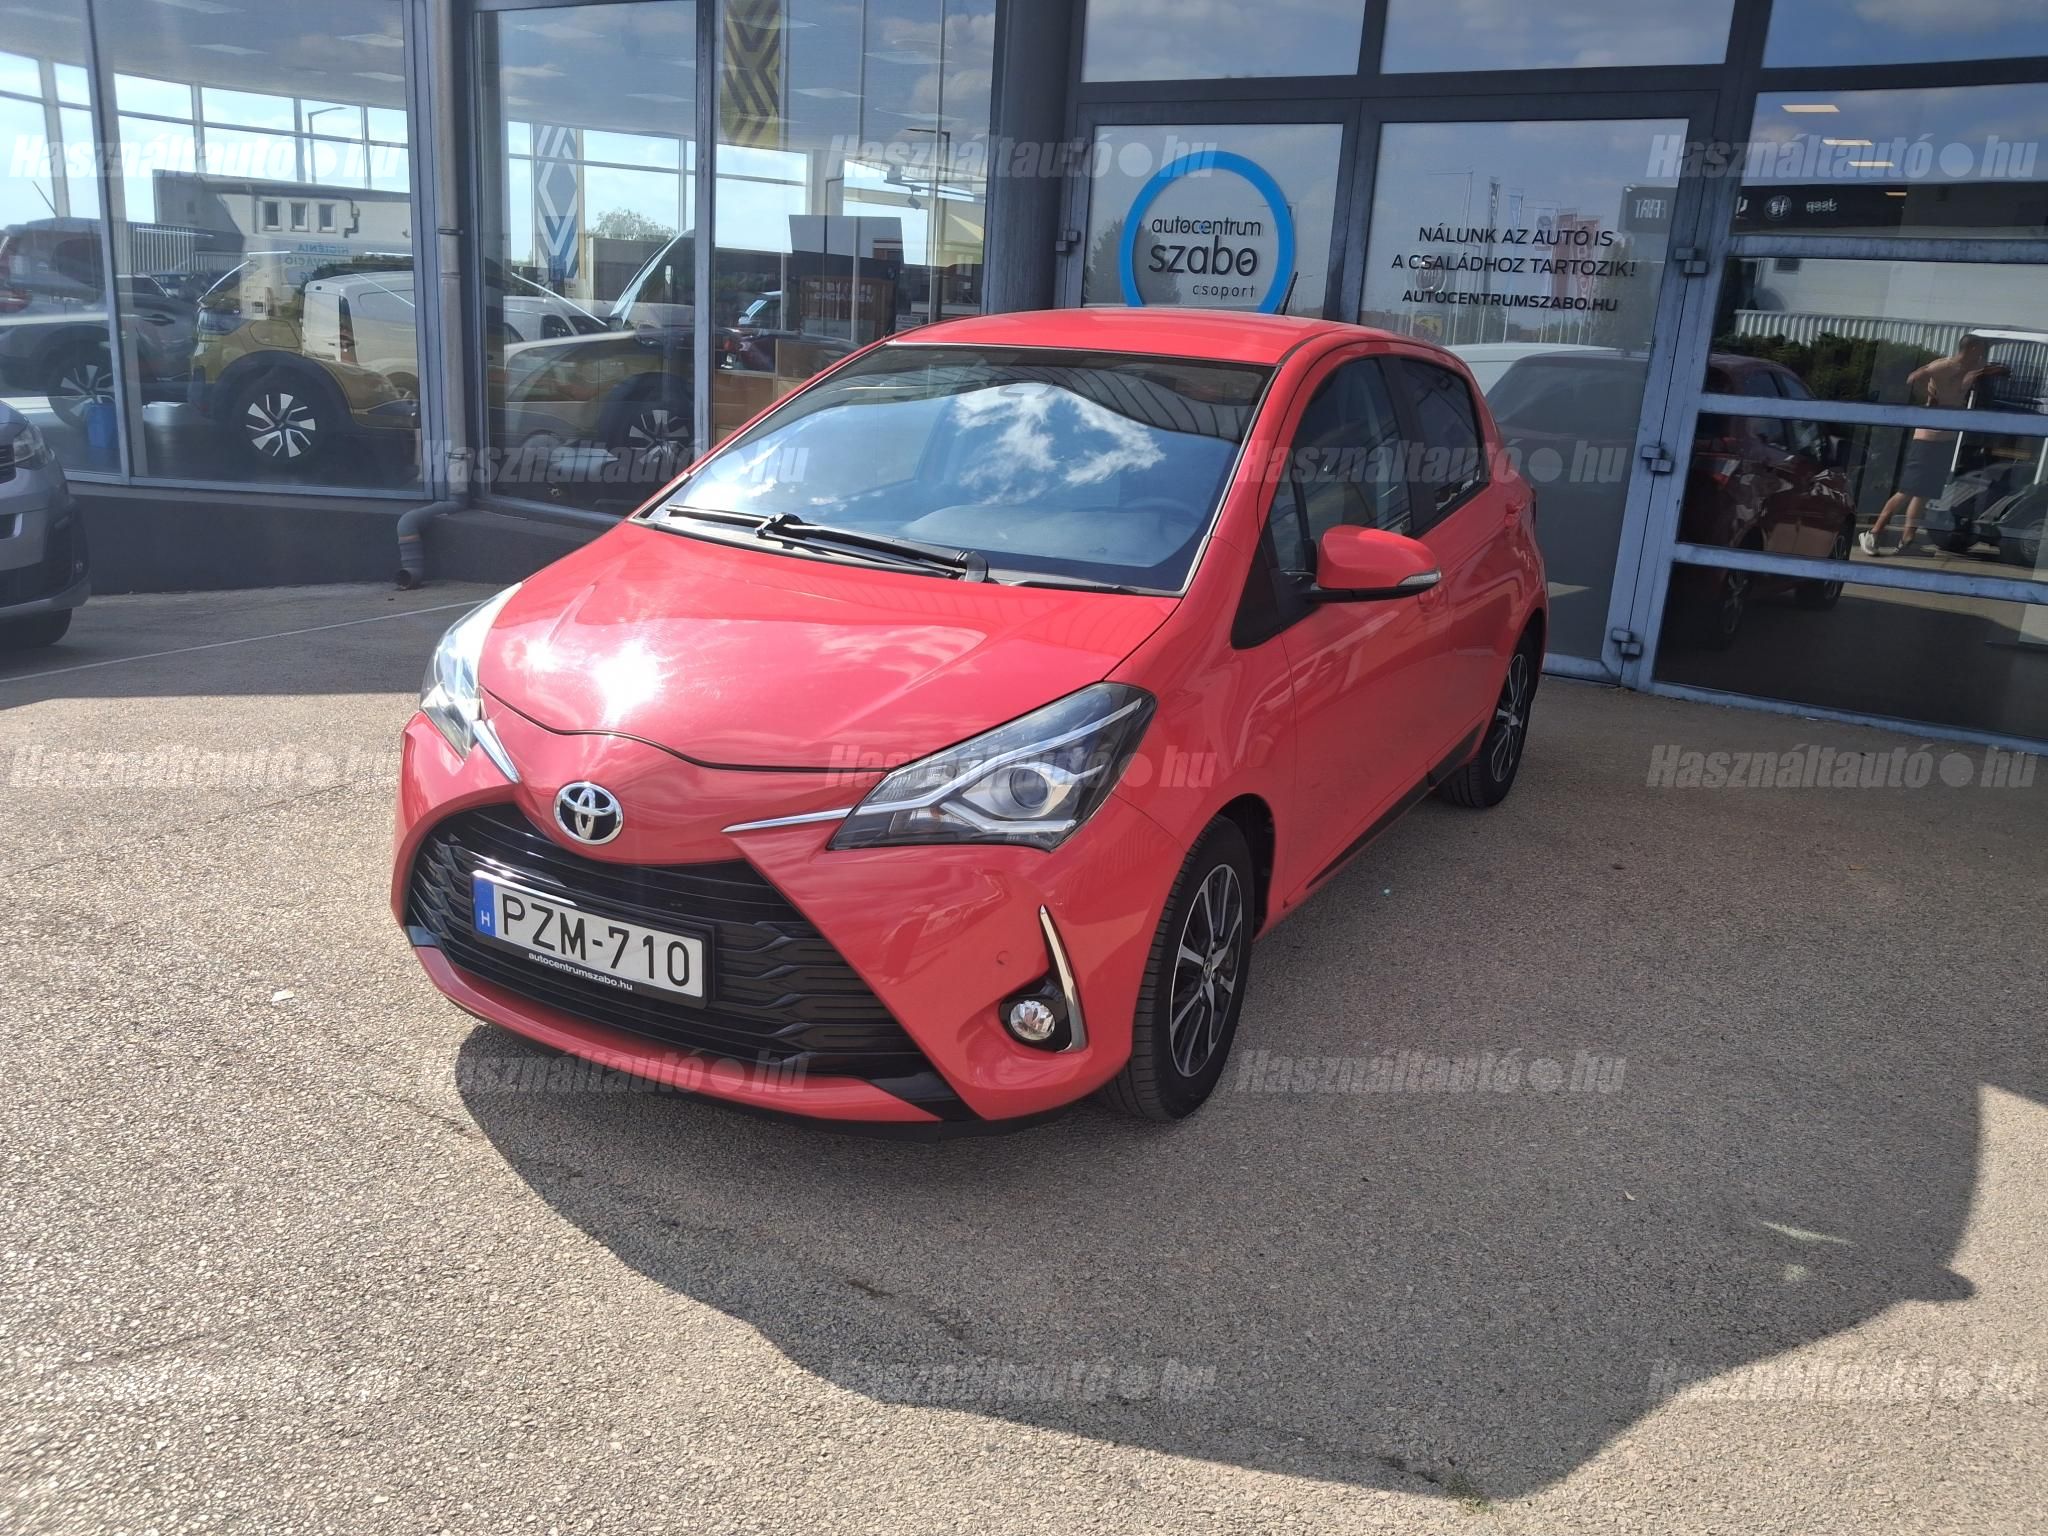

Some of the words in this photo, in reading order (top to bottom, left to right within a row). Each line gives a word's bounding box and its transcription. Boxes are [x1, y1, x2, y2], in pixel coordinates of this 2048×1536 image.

[1151, 216, 1261, 237] autocentrum
[1418, 222, 1497, 245] NÁLUNK
[1501, 229, 1528, 245] AZ
[1532, 226, 1590, 247] AUTÓ
[1594, 230, 1614, 247] IS
[1391, 254, 1404, 269] A
[1408, 252, 1525, 273] CSALÁDHOZ
[1529, 257, 1638, 278] TARTOZIK!
[1192, 283, 1256, 300] csoport
[1402, 289, 1619, 312] AUTOCENTRUMSZABO.HU
[481, 910, 491, 927] H
[501, 893, 690, 988] PZM-710
[528, 952, 633, 991] autocentrumszabo.hu
